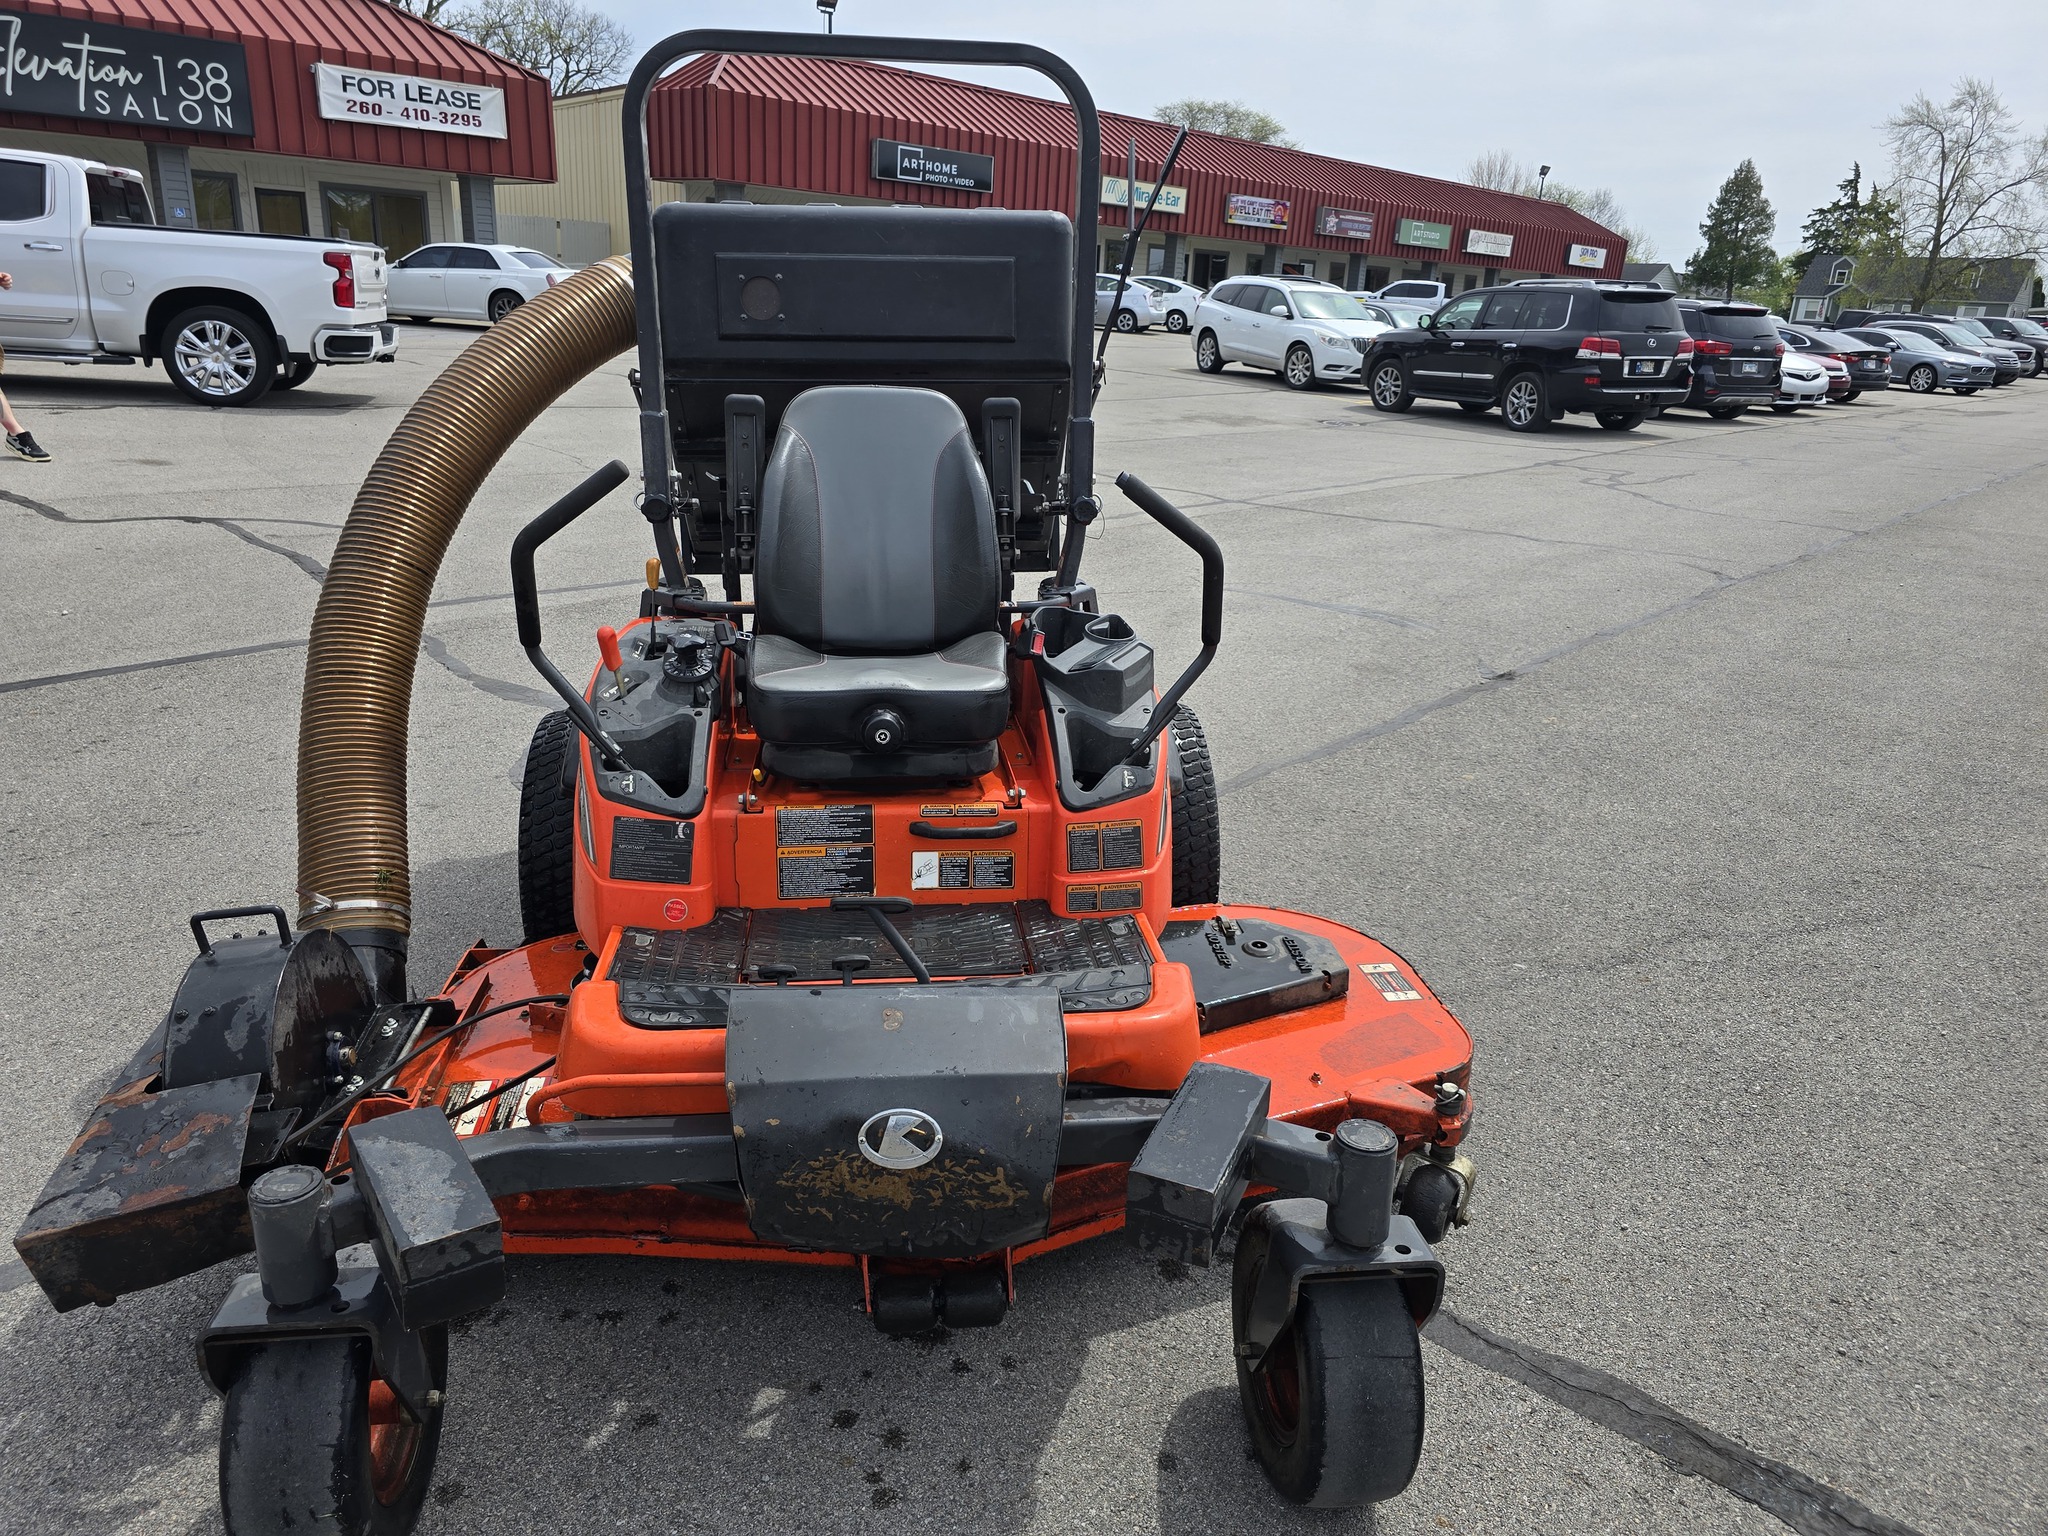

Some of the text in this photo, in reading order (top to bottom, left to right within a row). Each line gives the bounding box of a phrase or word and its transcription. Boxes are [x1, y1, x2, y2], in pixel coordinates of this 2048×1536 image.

[0, 16, 232, 111] levation 138
[94, 90, 233, 128] SALON
[341, 75, 482, 111] FOR LEASE
[346, 100, 382, 117] 260
[400, 107, 482, 128] 410-3295
[902, 157, 958, 175] ARTHOME
[925, 173, 948, 184] PHOTO
[954, 178, 975, 187] VIDEO
